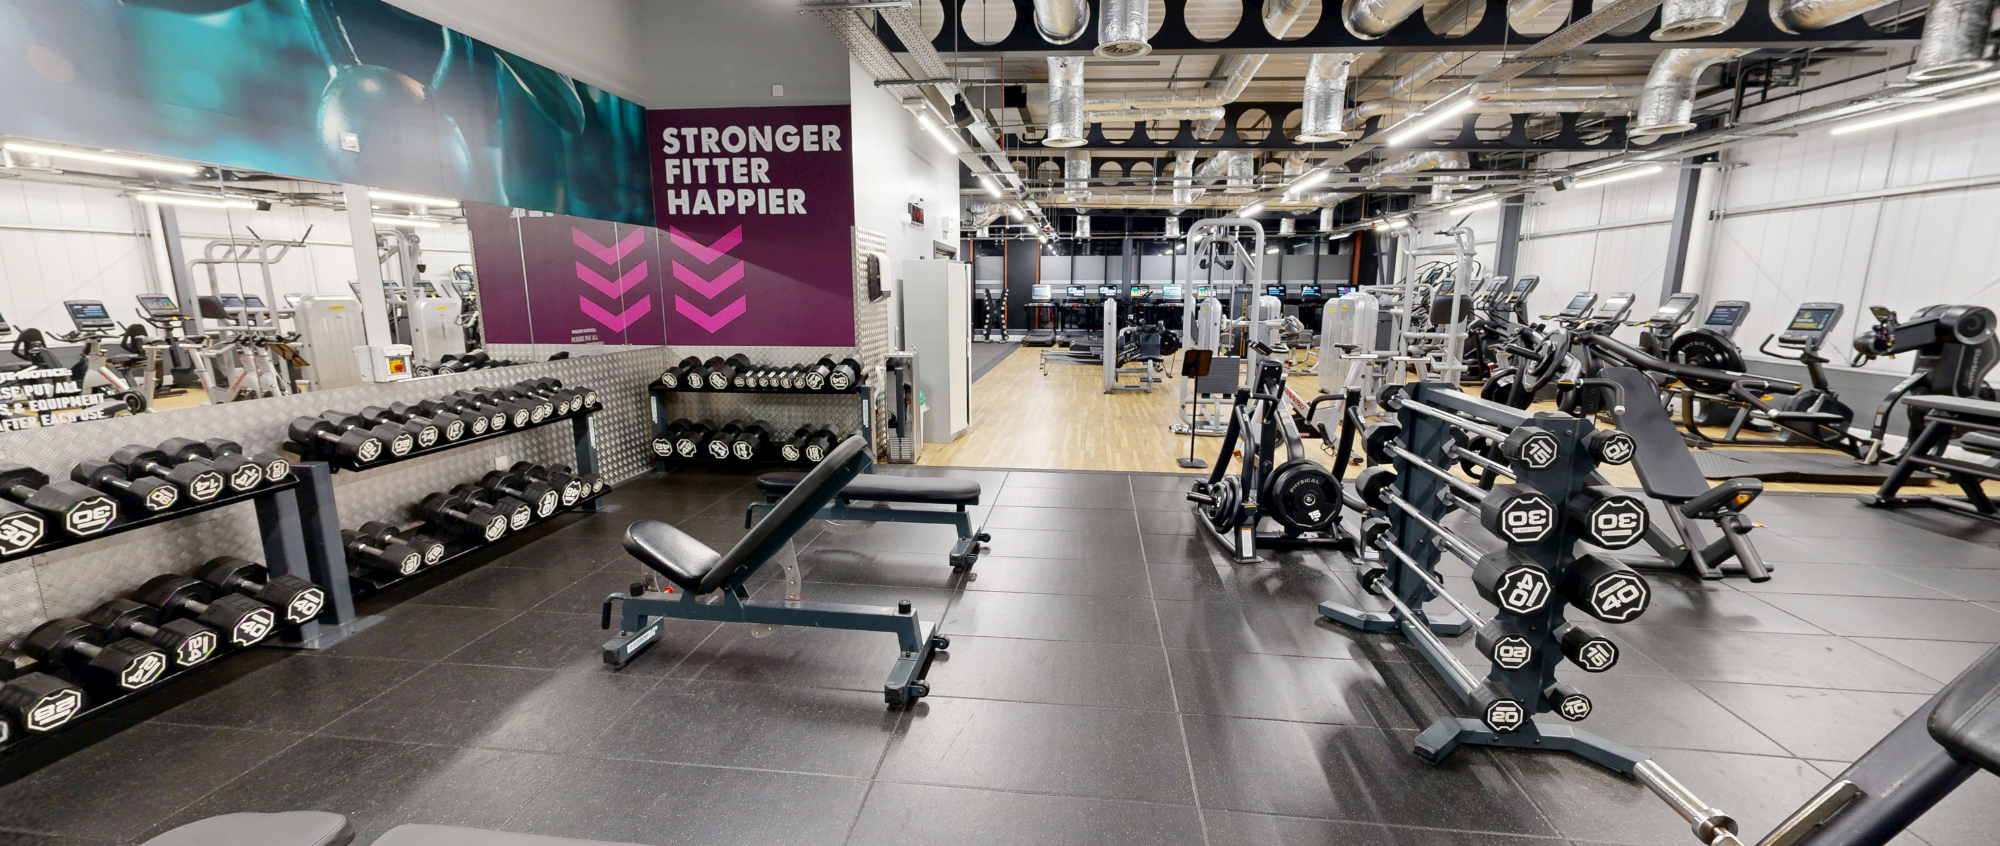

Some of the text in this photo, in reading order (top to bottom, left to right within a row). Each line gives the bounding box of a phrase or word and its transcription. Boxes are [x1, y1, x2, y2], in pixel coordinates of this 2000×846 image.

[662, 124, 842, 154] STRONGER
[665, 157, 771, 184] FITTER
[667, 188, 807, 215] HAPPIER
[0, 381, 82, 400] SE PUT ALL
[13, 402, 25, 414] &
[29, 393, 105, 412] EQUIPMENT
[41, 411, 78, 426] EACH
[80, 408, 105, 421] USE
[1606, 441, 1632, 457] 10
[197, 474, 219, 492] 14
[1290, 478, 1320, 493] PHYSICAL
[73, 505, 111, 525] 30
[1508, 509, 1547, 527] 30
[1598, 513, 1638, 529] 30
[0, 524, 34, 547] 30
[1508, 573, 1534, 607] 40
[1602, 584, 1640, 612] 40
[294, 597, 317, 615] 40
[240, 620, 266, 637] 40
[1499, 645, 1527, 659] 20
[1492, 711, 1519, 723] 20
[1565, 702, 1587, 715] 10
